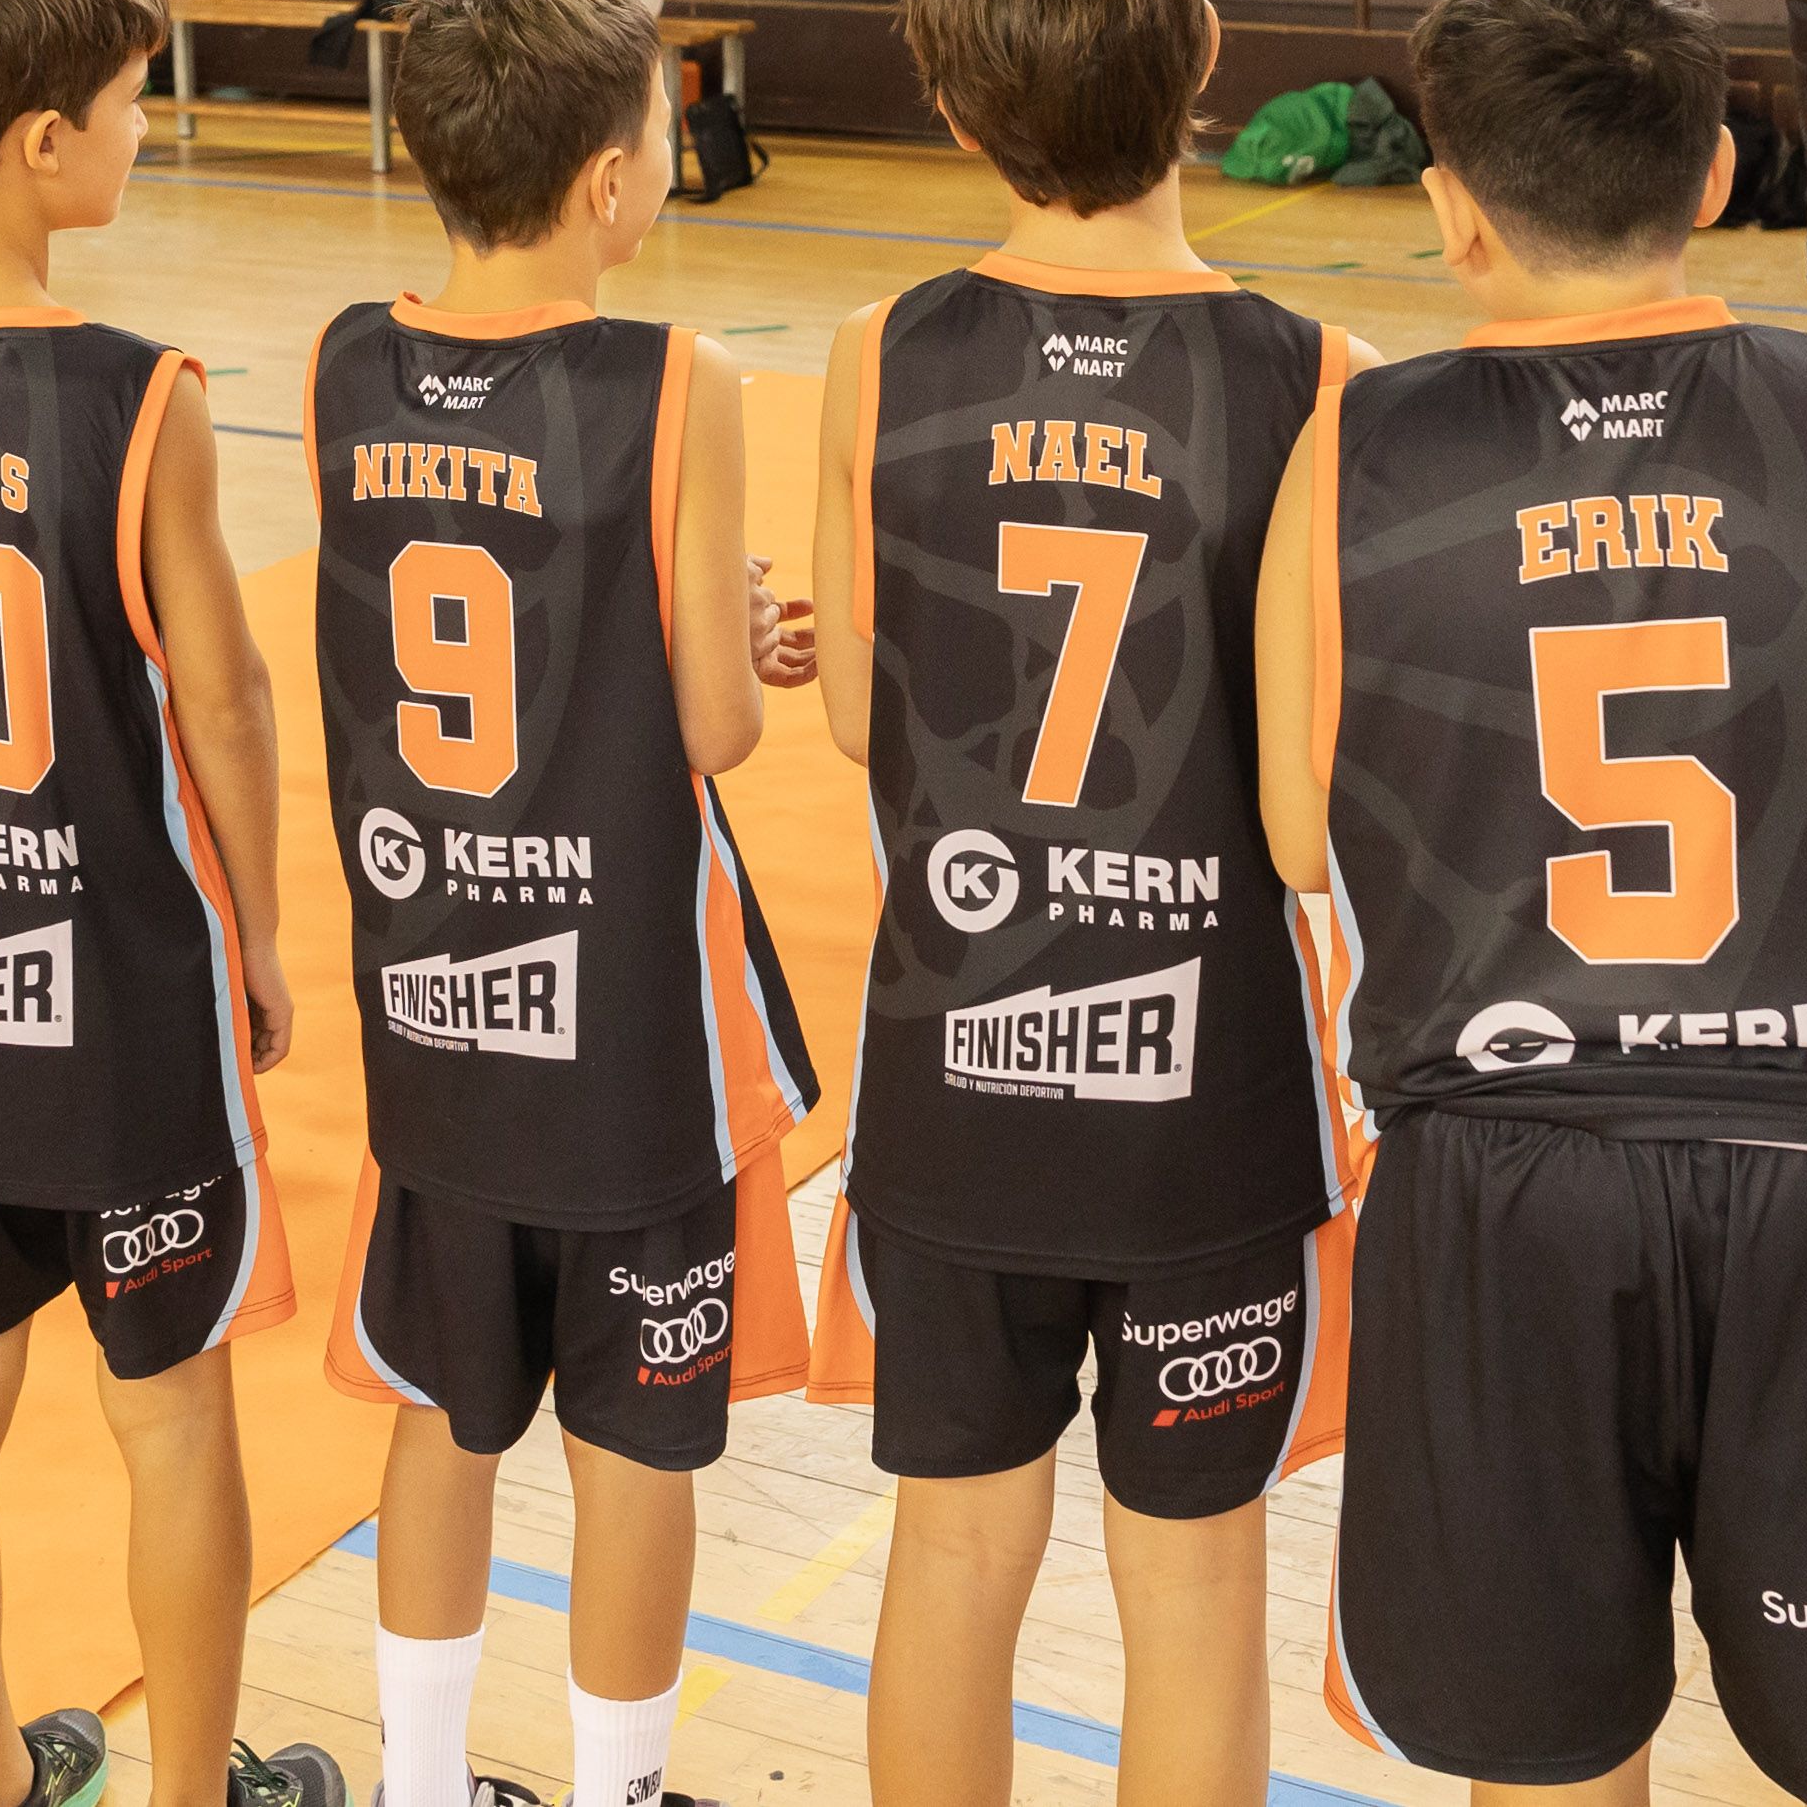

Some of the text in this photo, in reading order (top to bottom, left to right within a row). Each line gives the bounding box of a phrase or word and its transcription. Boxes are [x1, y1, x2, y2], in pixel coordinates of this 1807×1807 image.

[1074, 334, 1129, 356] MARC
[447, 374, 494, 392] MARC
[1072, 357, 1125, 378] MART
[443, 393, 487, 411] MART
[1601, 391, 1669, 414] MARC
[1602, 417, 1664, 440] MART
[352, 442, 543, 519] NIKITA
[989, 420, 1162, 501] NAEL
[1516, 494, 1729, 585] ERIK
[388, 539, 519, 799] 9
[997, 521, 1148, 808] 7
[1528, 616, 1740, 965] 5
[444, 828, 593, 880] KERN
[447, 879, 594, 906] PHARMA
[1047, 848, 1220, 905] KERN
[1048, 902, 1220, 933] PHARMA
[388, 960, 557, 1035] FINISHER
[952, 993, 1178, 1077] FINISHER
[944, 1072, 968, 1089] SALUD
[968, 1080, 974, 1090] Y
[1019, 1085, 1064, 1100] DEPORTIVA
[123, 1247, 213, 1294] Audi Sport
[653, 1345, 733, 1387] Audi Spor
[1184, 1381, 1286, 1423] Audi Sport
